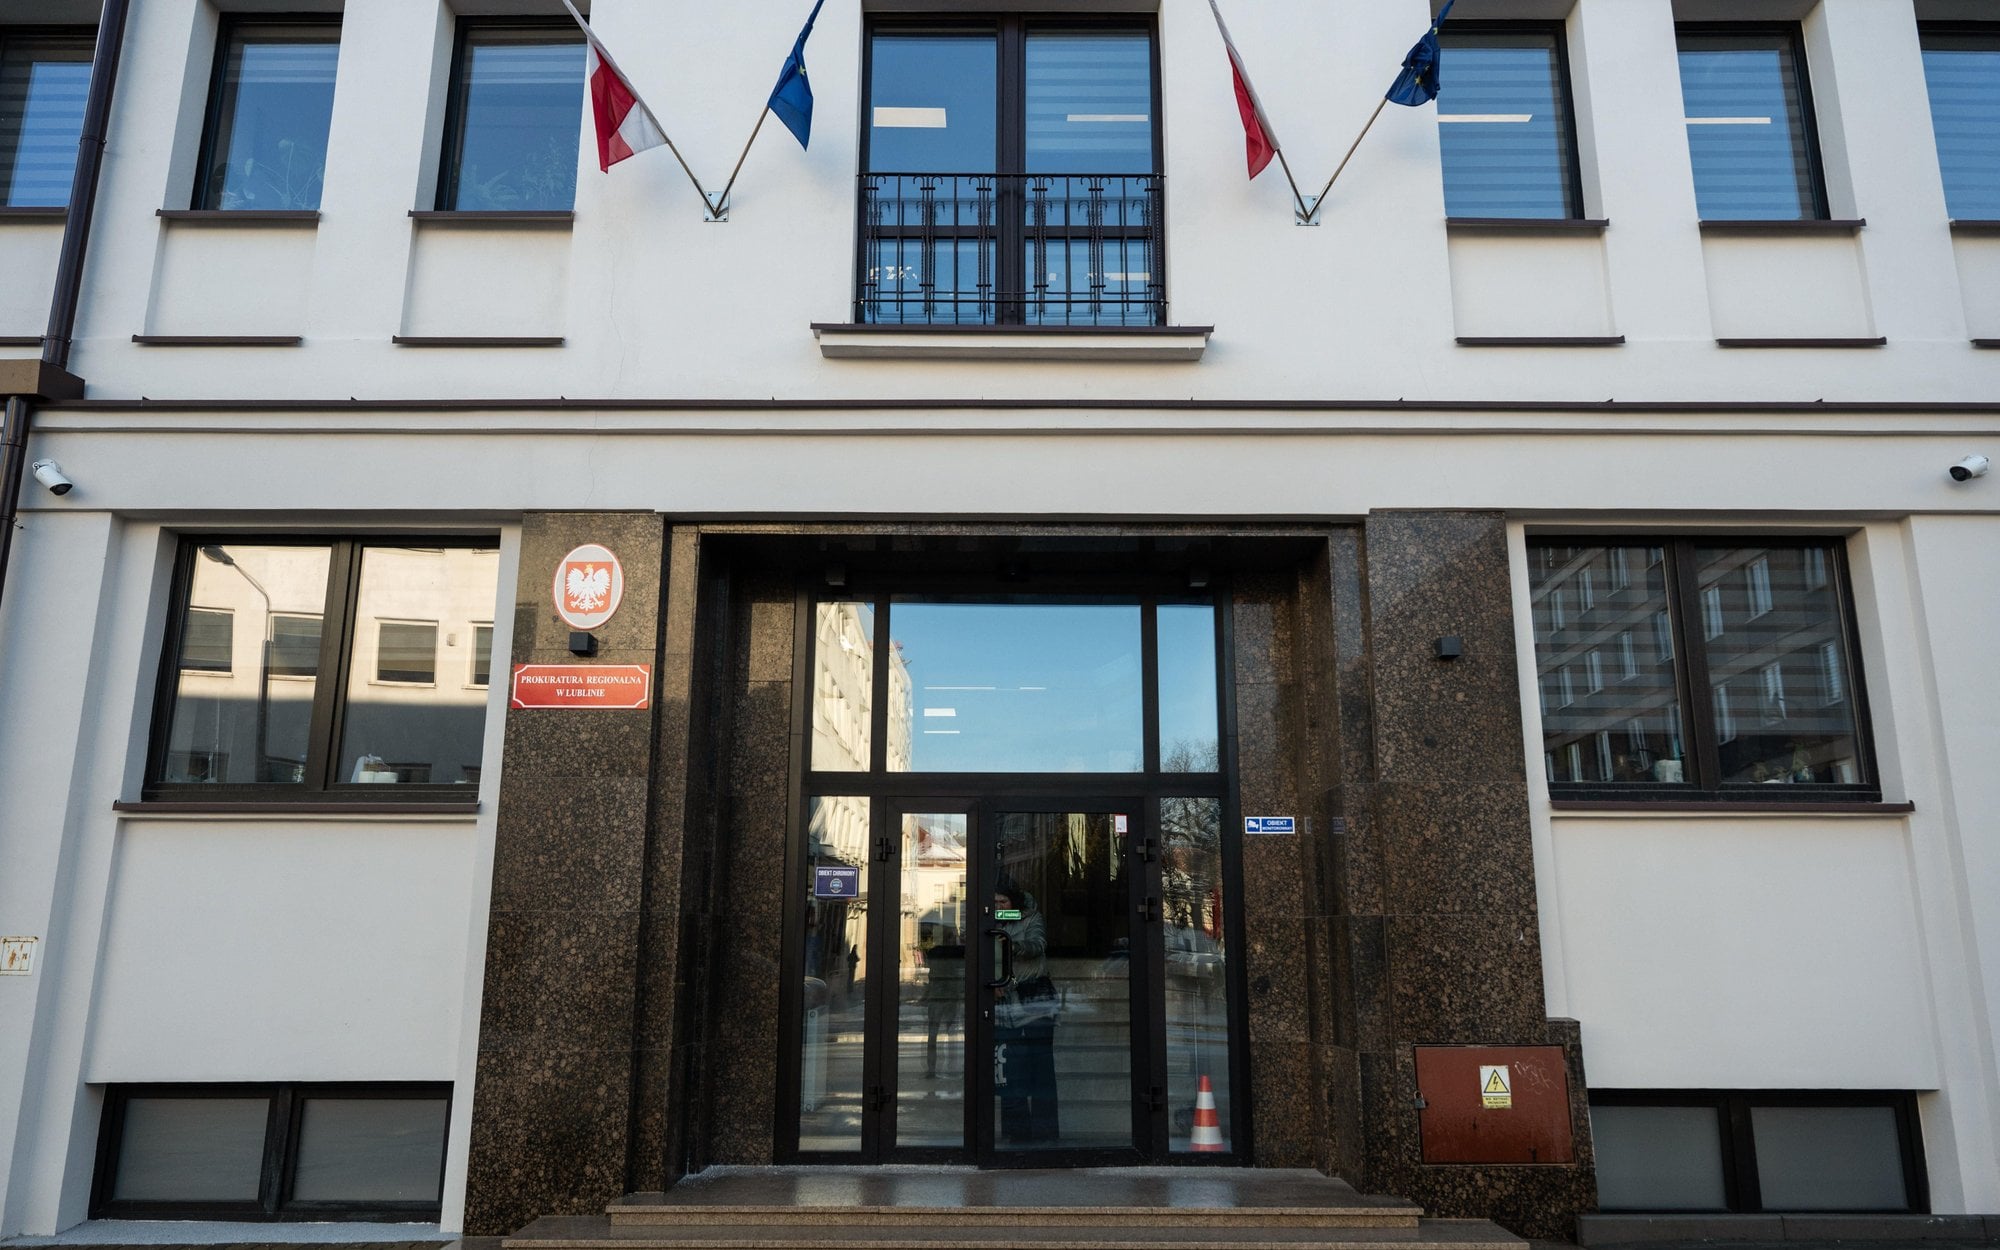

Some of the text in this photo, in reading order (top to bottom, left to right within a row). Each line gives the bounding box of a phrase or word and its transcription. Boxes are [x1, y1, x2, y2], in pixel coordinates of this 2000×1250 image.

[521, 675, 642, 684] PROKURATURA REGIONALNA
[556, 689, 605, 697] W LUBLINIE
